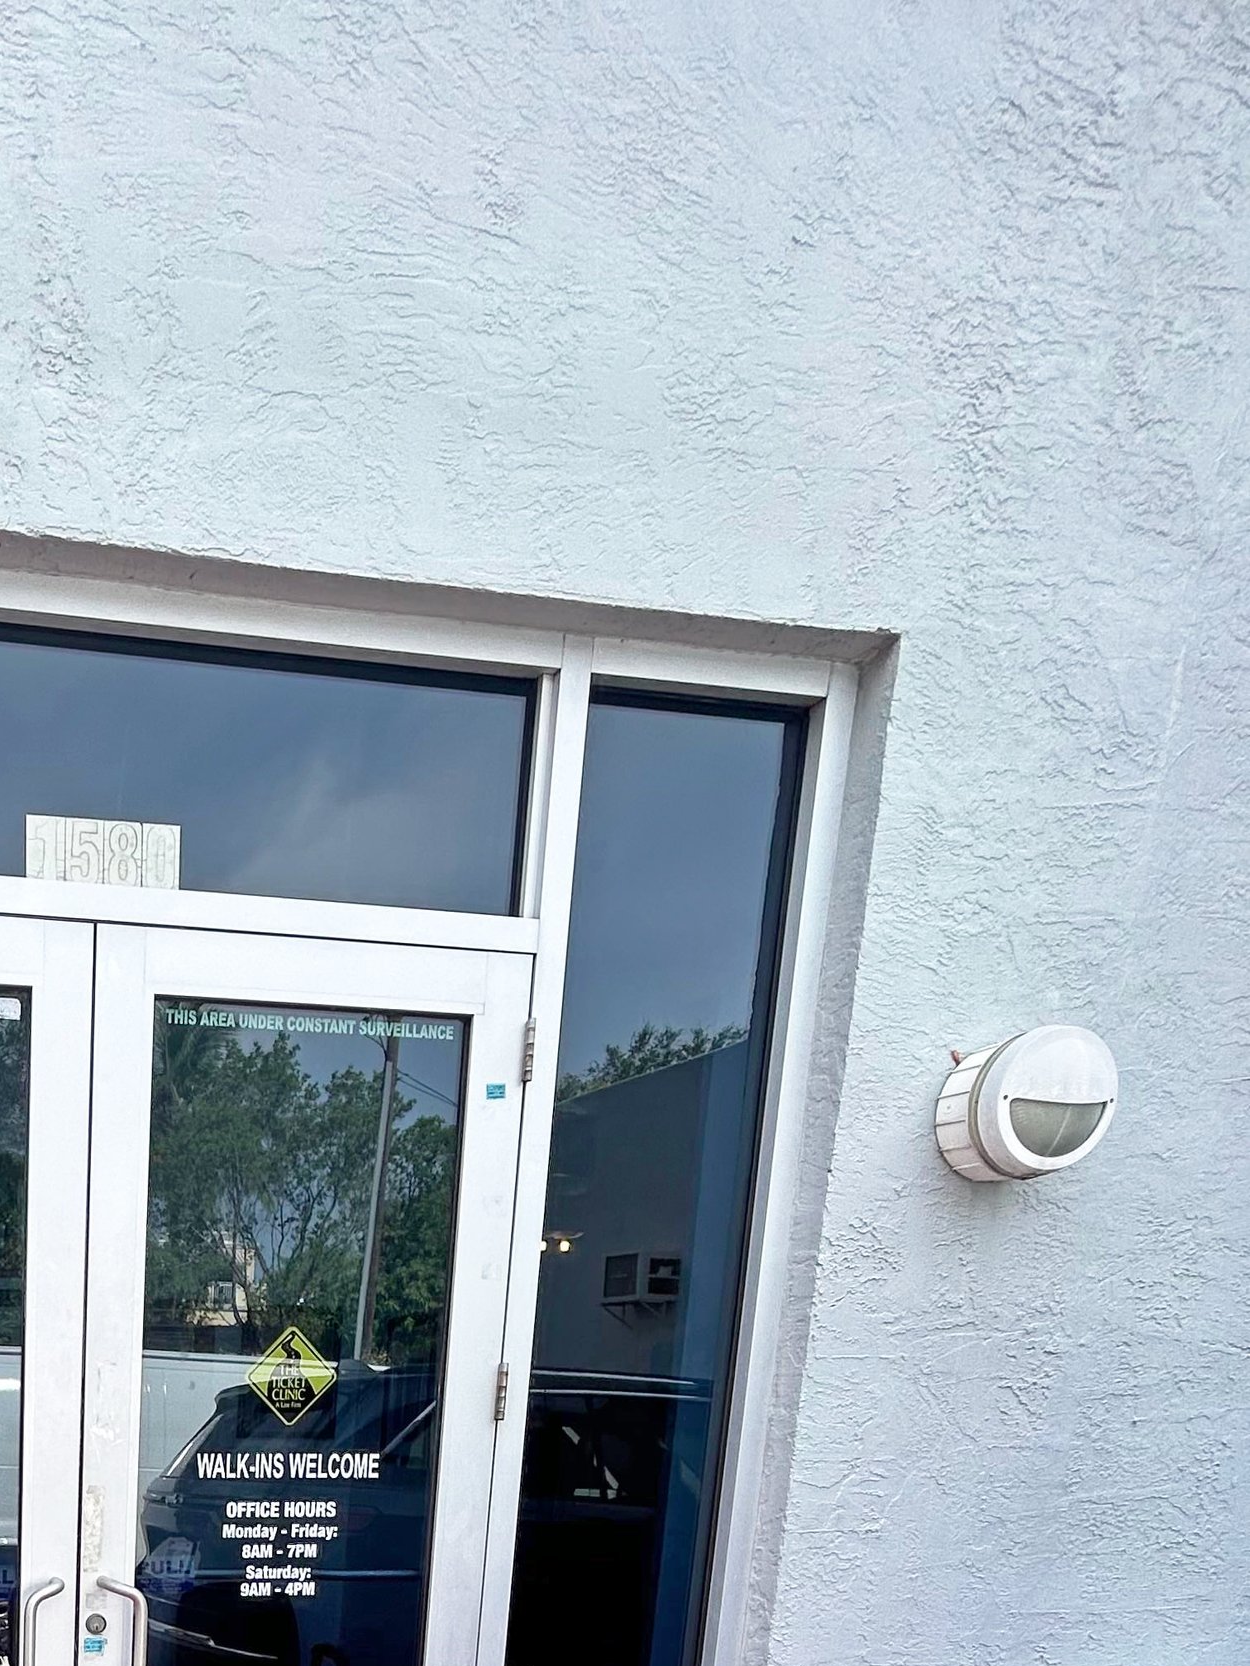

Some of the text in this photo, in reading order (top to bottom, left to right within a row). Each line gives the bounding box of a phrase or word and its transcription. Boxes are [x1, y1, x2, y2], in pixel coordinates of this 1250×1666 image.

[28, 819, 176, 889] 1580
[166, 1009, 454, 1039] THIS AREA UNDER CONSTANT SURVEILLANCE
[280, 1365, 300, 1375] THE
[271, 1376, 306, 1388] TICKET
[271, 1389, 306, 1400] CLINIC
[197, 1453, 380, 1479] WALK-INS WELCOME
[226, 1502, 337, 1518] OFFICE HOURS
[222, 1524, 277, 1540] Monday
[291, 1524, 338, 1540] Friday:
[242, 1545, 273, 1558] 8AM
[287, 1544, 317, 1558] 7PM
[246, 1565, 311, 1580] Saturday:
[240, 1583, 271, 1596] 9AM
[285, 1582, 315, 1596] 4PM
